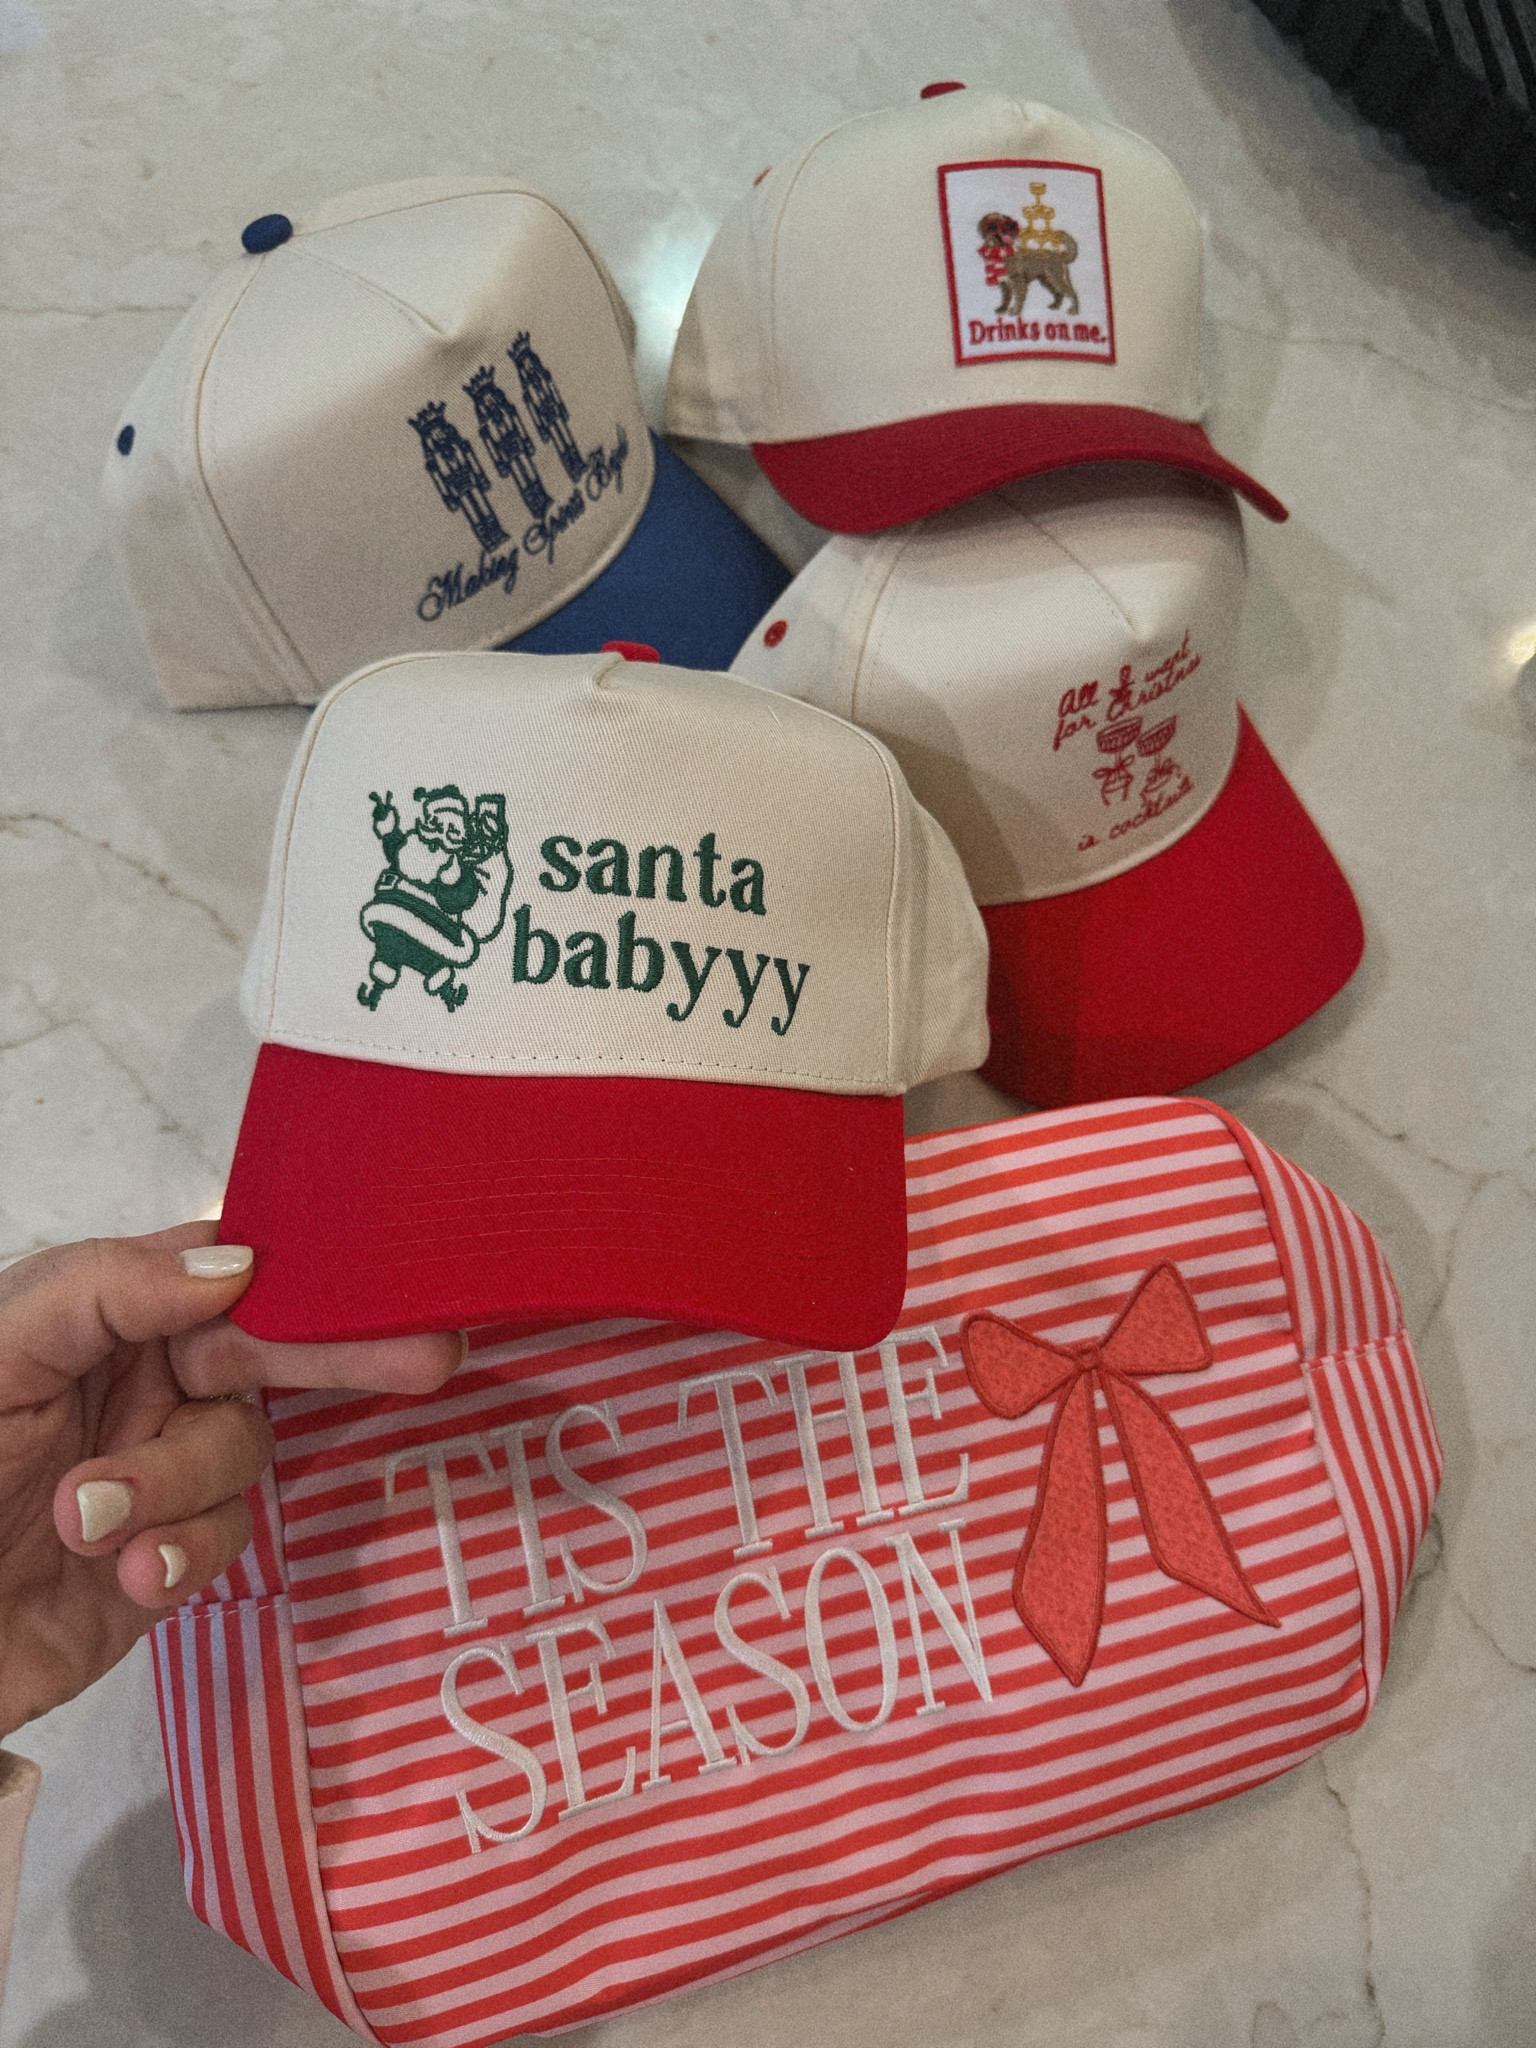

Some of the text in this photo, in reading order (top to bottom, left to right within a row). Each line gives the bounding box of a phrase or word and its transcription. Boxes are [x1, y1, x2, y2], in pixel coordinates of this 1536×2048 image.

[967, 316, 1107, 346] Drinks on me.
[416, 548, 519, 622] Making
[1143, 626, 1191, 683] want
[1052, 715, 1097, 752] for
[539, 831, 768, 916] santa
[512, 903, 811, 1036] babyyy
[384, 1325, 970, 1637] TIS THE
[439, 1518, 993, 1854] SEASON
